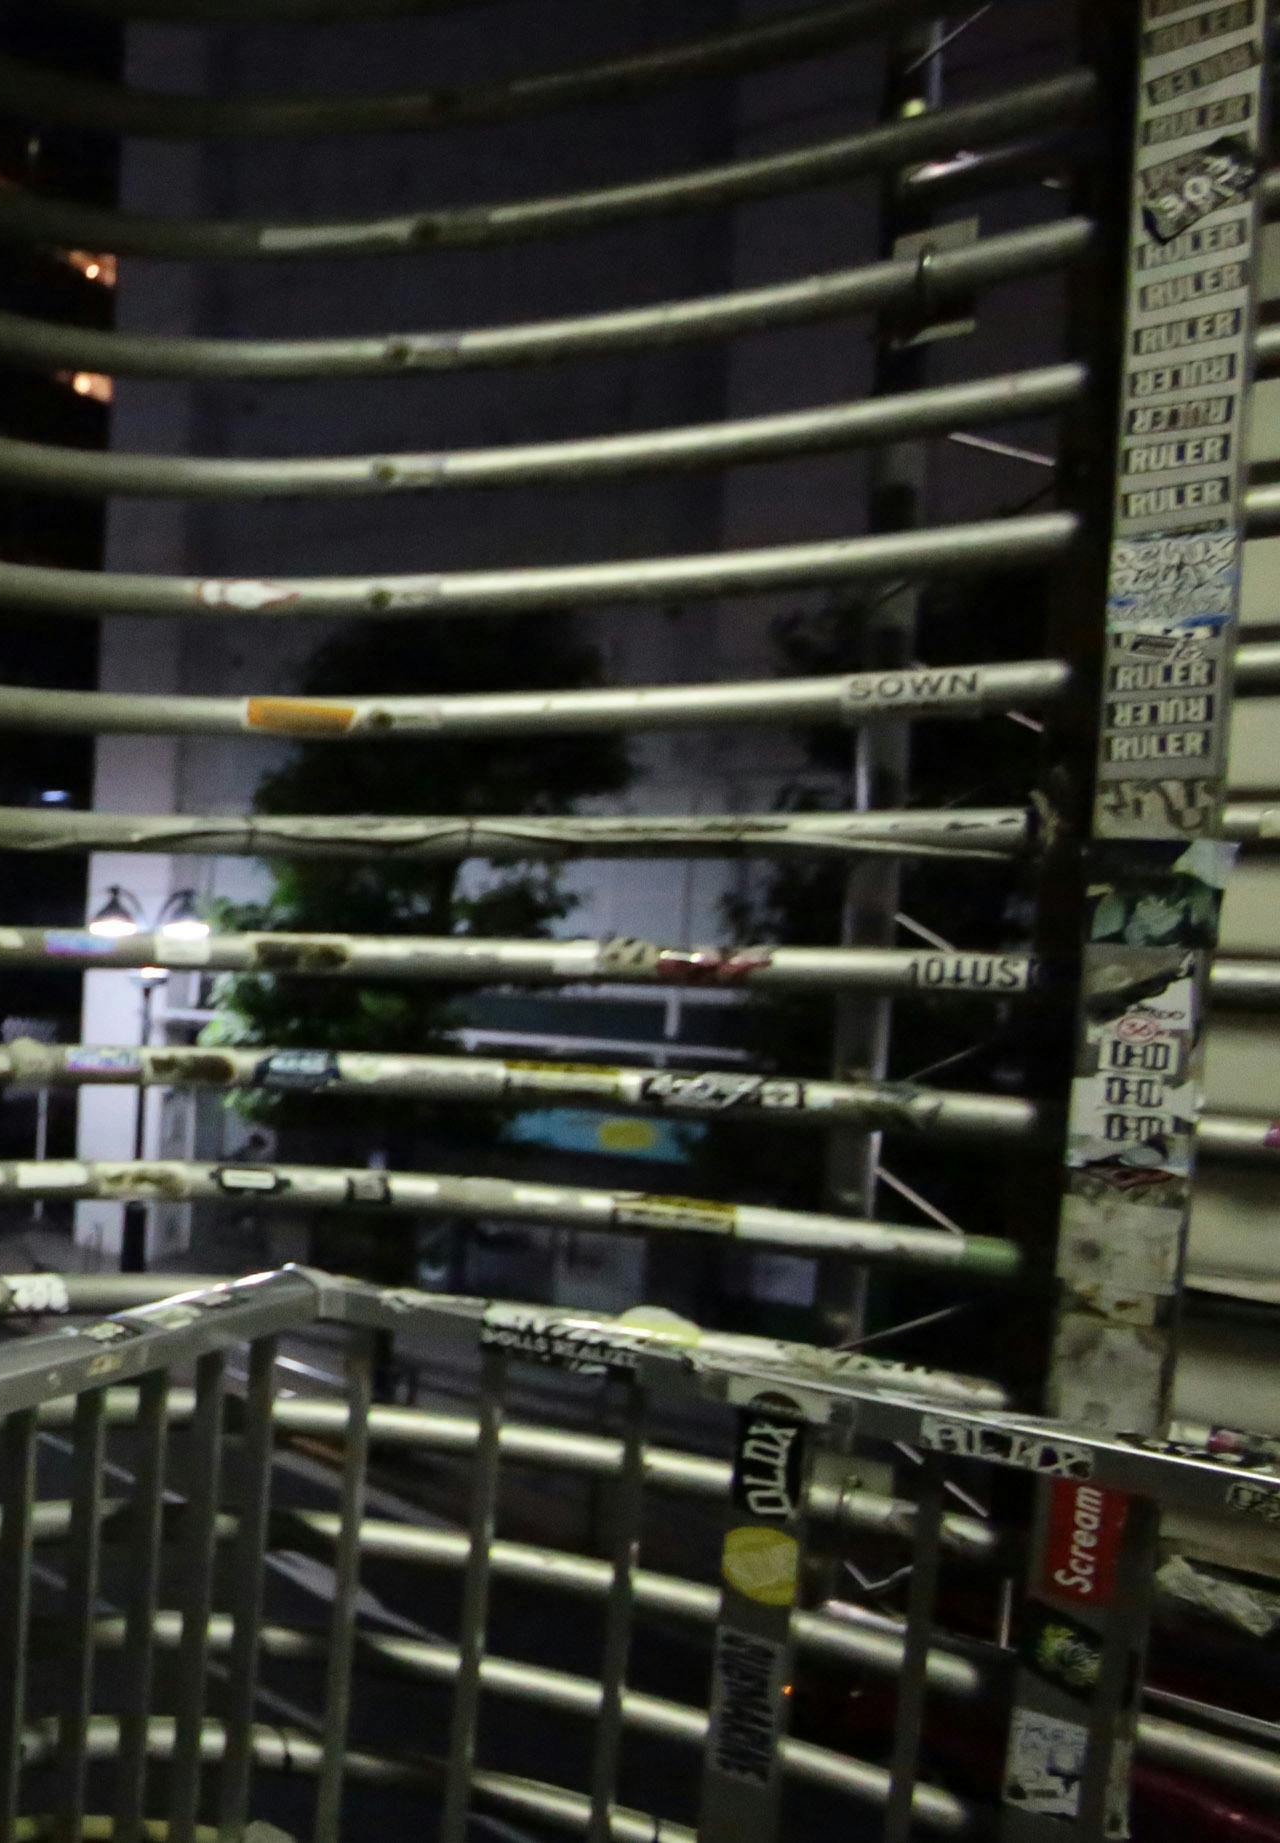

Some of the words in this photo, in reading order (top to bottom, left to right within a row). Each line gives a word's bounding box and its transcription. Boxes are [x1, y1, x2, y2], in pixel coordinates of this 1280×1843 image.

[1144, 265, 1243, 310] RULER
[1140, 313, 1237, 354] RULER
[1135, 358, 1231, 397] RULER
[1132, 400, 1229, 434] RULER
[1128, 438, 1224, 474] RULER
[1128, 480, 1224, 517] RULER
[848, 671, 978, 699] SOWN
[1115, 664, 1209, 691] RULER
[1112, 698, 1207, 727] RULER
[1111, 731, 1205, 761] RULER
[1053, 1485, 1106, 1594] Scream
